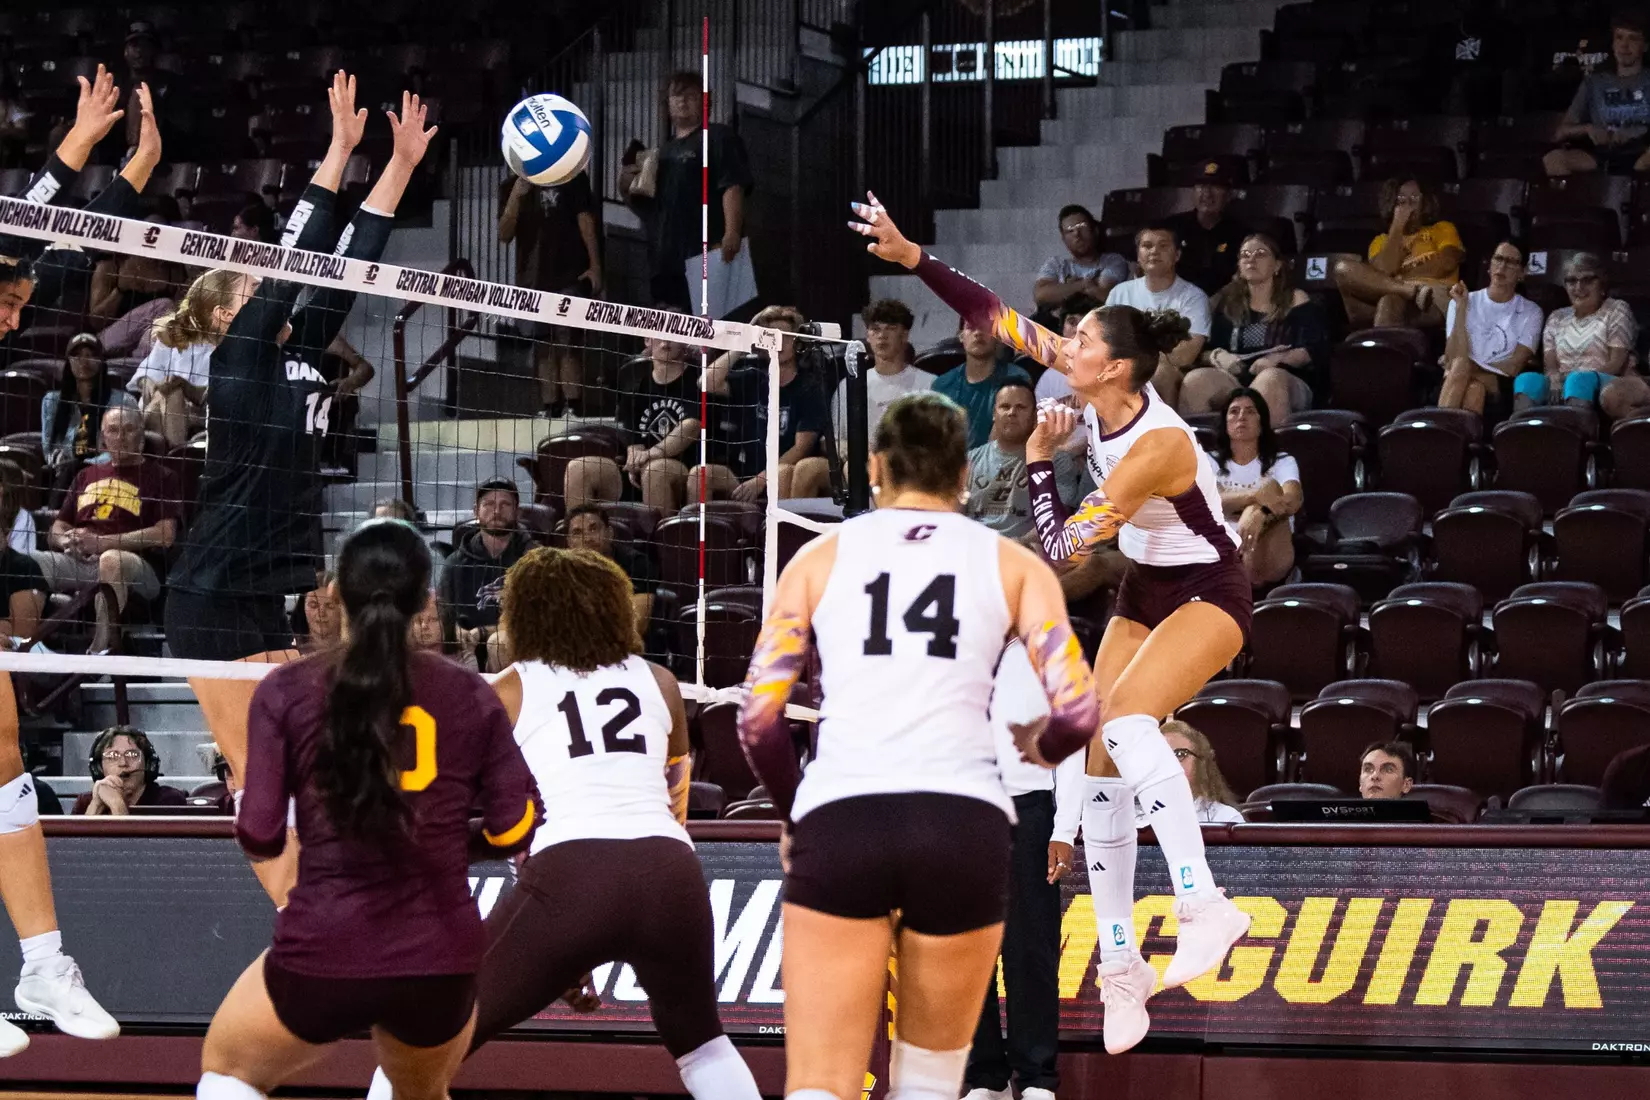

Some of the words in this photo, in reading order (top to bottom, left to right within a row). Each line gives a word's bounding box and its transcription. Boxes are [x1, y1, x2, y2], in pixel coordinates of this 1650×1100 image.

[51, 209, 122, 243] VOLLEYBALL
[180, 232, 228, 261] CENTRAL
[229, 240, 286, 270] MICHIGAN
[284, 249, 347, 280] VOLLEYBALL
[396, 269, 440, 296] CENTRAL
[439, 276, 488, 304] MICHIGAN
[487, 285, 542, 313] VOLLEYBALL
[585, 302, 622, 325] CENTRAL
[623, 307, 665, 331] MICHIGAN
[665, 314, 715, 340] VOLLEYBALL
[305, 391, 333, 438] 14
[1032, 492, 1084, 561] CHIPPEWAS
[863, 571, 960, 660] 14
[557, 687, 647, 758] 12
